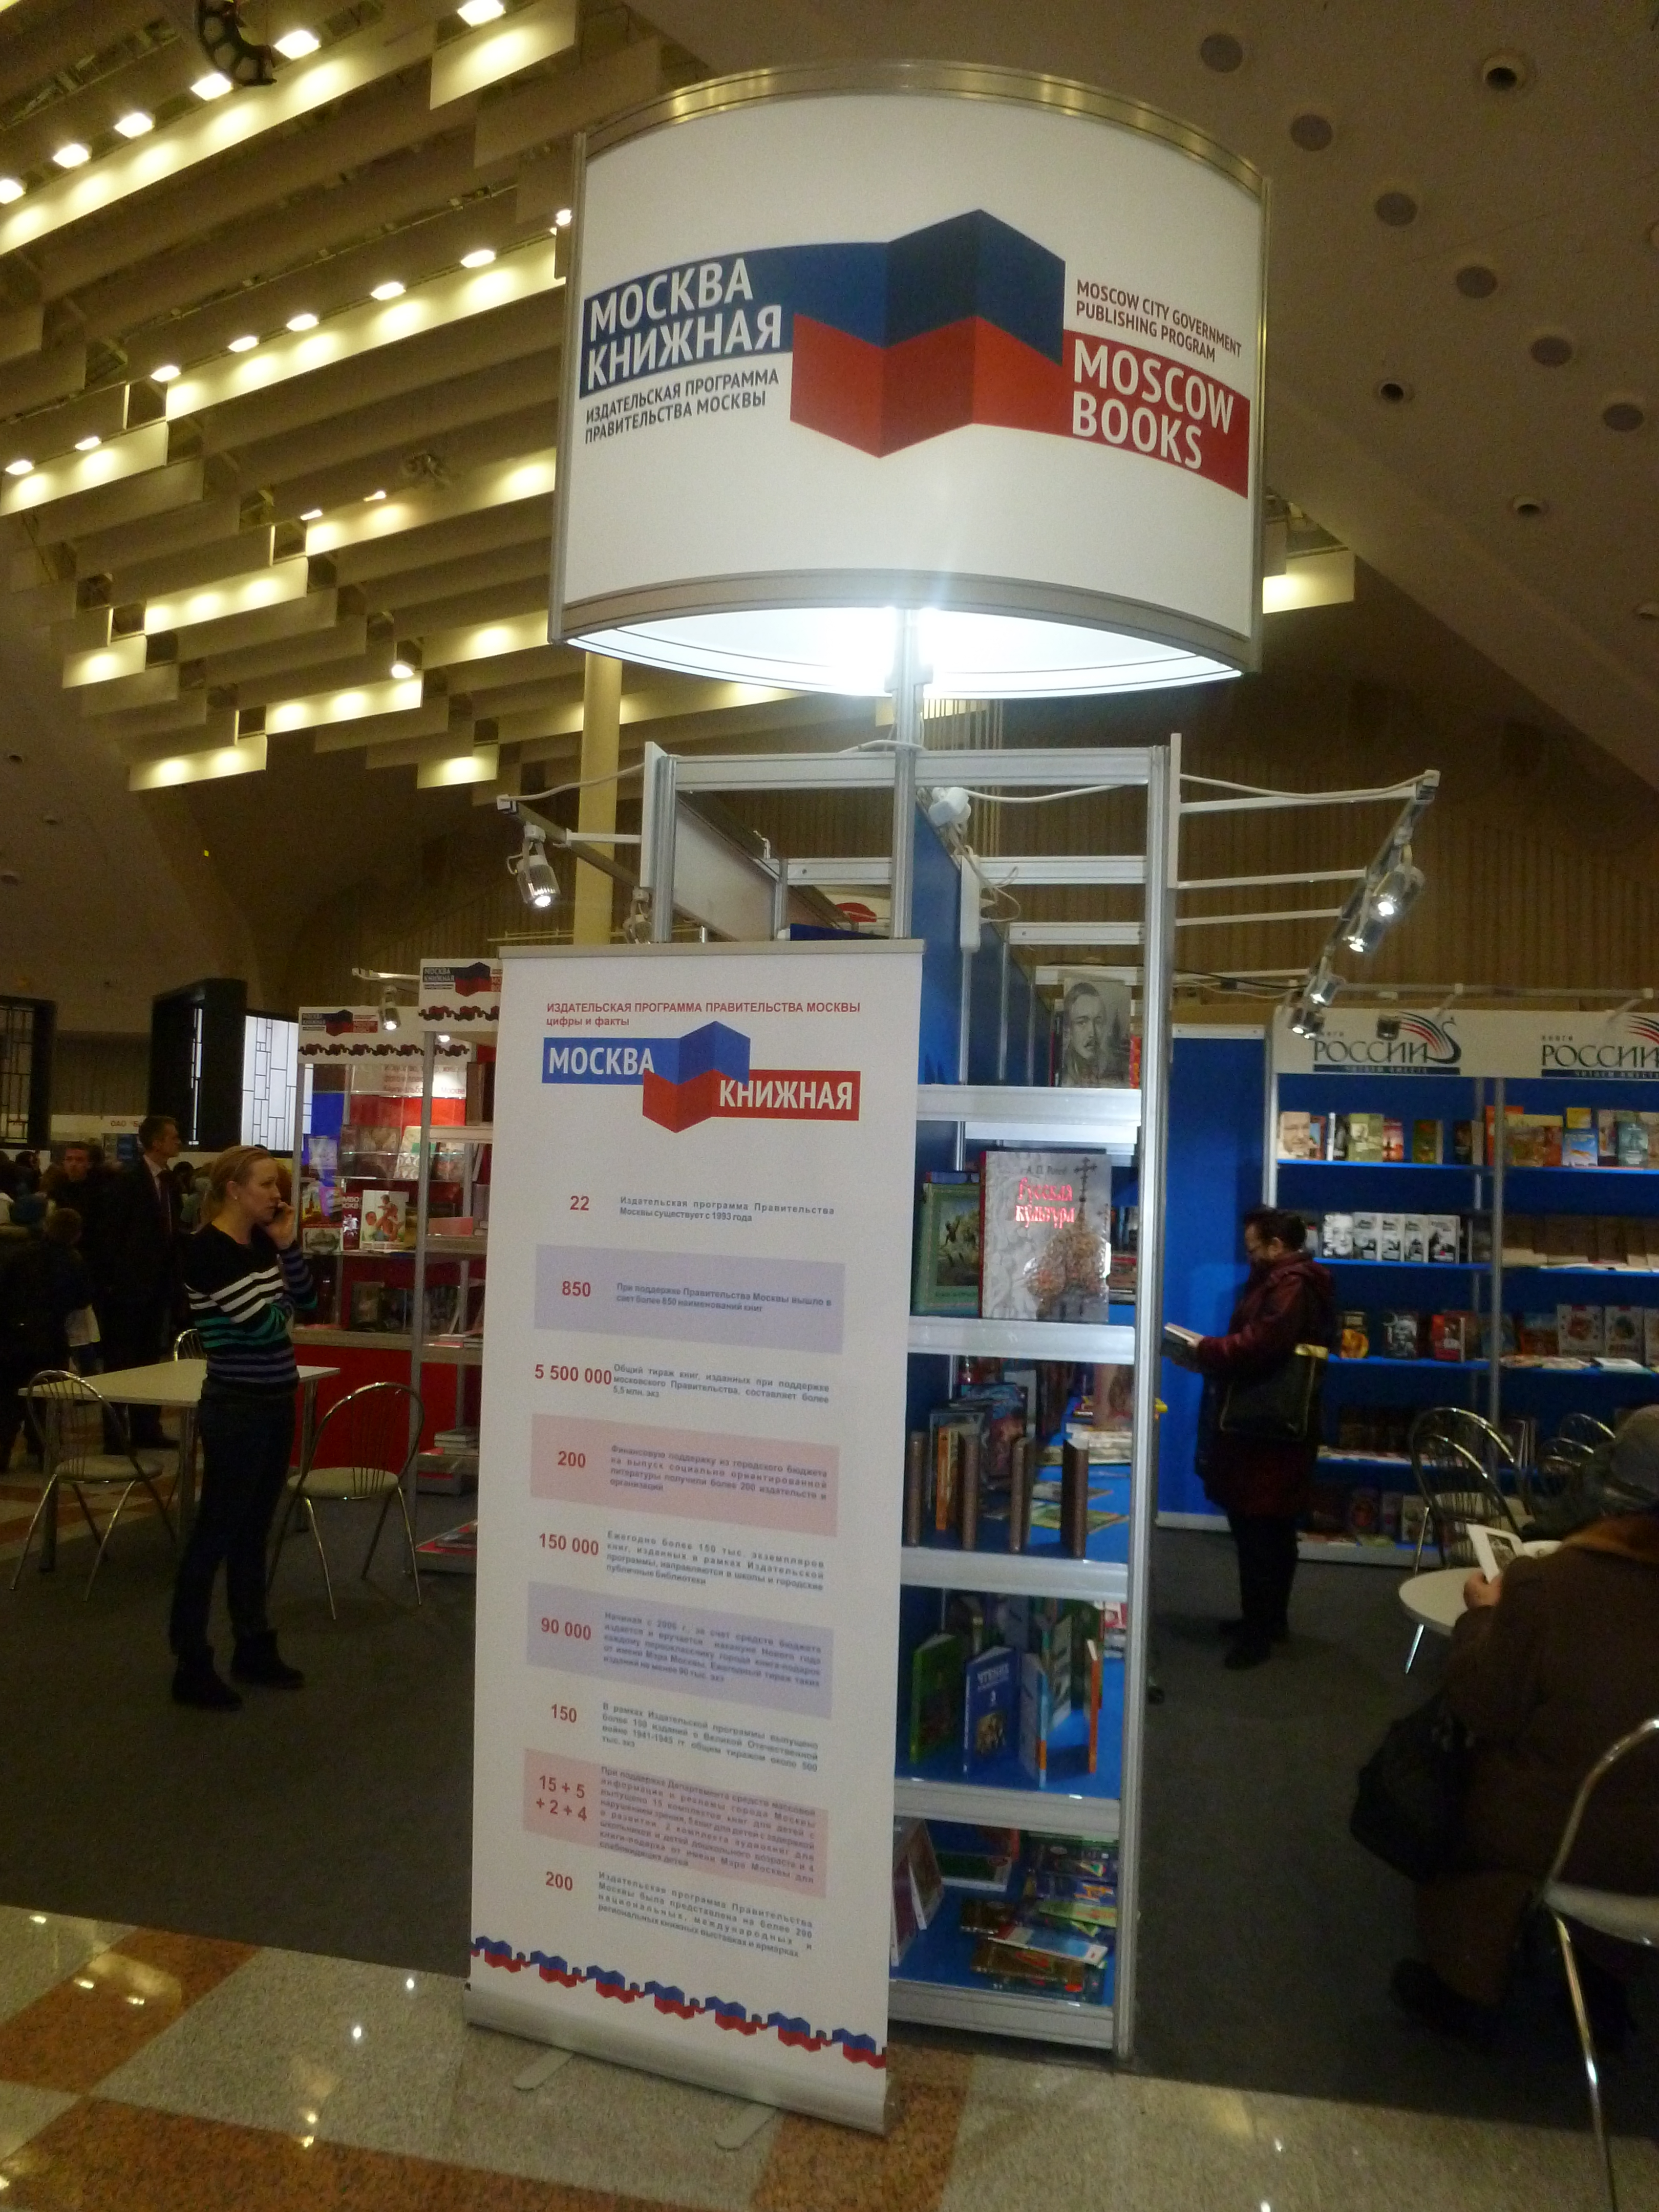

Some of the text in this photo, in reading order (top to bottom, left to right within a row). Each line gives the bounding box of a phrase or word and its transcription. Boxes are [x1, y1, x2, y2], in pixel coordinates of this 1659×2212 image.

[590, 258, 753, 342] МОСКВА
[1077, 279, 1242, 358] MOSCOW CITY GOVERNMENT
[1076, 301, 1216, 362] PUBLISHING PROGRAM
[588, 305, 781, 391] КНИЖНАЯ
[586, 368, 779, 424] ИЗДАТЕЛЬСКАЯ ПРОГРАММА
[1074, 339, 1233, 434] MOSCOW
[585, 391, 766, 444] ПРАВИТЕЛЬСТВА МОСКВЫ
[1073, 391, 1202, 470] BOOKS
[546, 1002, 861, 1014] ИЗДАТЕЛЬСКАЯ ПРОГРАММА ПРАВИТЕЛЬСТВА МОСКВЫ
[546, 1017, 583, 1027] цифры
[595, 1017, 630, 1027] факты
[549, 1048, 654, 1075] МОСКВА
[1314, 1040, 1428, 1064] РОССИИ
[719, 1080, 853, 1110] КНИЖНАЯ
[1018, 1177, 1073, 1204] Русская
[570, 1196, 589, 1211] 22
[620, 1196, 835, 1215] Издательская программа Правительства
[620, 1207, 653, 1216] Москвы
[654, 1210, 704, 1220] существует
[712, 1211, 732, 1220] 1993
[732, 1214, 752, 1222] года
[1015, 1204, 1075, 1229] культура
[562, 1281, 591, 1297] 850
[662, 1297, 676, 1306] 850
[535, 1364, 612, 1385] 5 500 000
[614, 1364, 643, 1374] Общий
[648, 1368, 674, 1378] тираж
[756, 1378, 773, 1388] при
[778, 1380, 830, 1392] поддержке
[558, 1451, 586, 1468] 200
[539, 1533, 599, 1556] 150 000
[541, 1617, 592, 1641] 90 000
[551, 1704, 577, 1723] 150
[539, 1775, 557, 1792] 15
[576, 1783, 585, 1799] 5
[549, 1799, 559, 1815] 2
[578, 1806, 587, 1822] 4
[545, 1871, 573, 1891] 200
